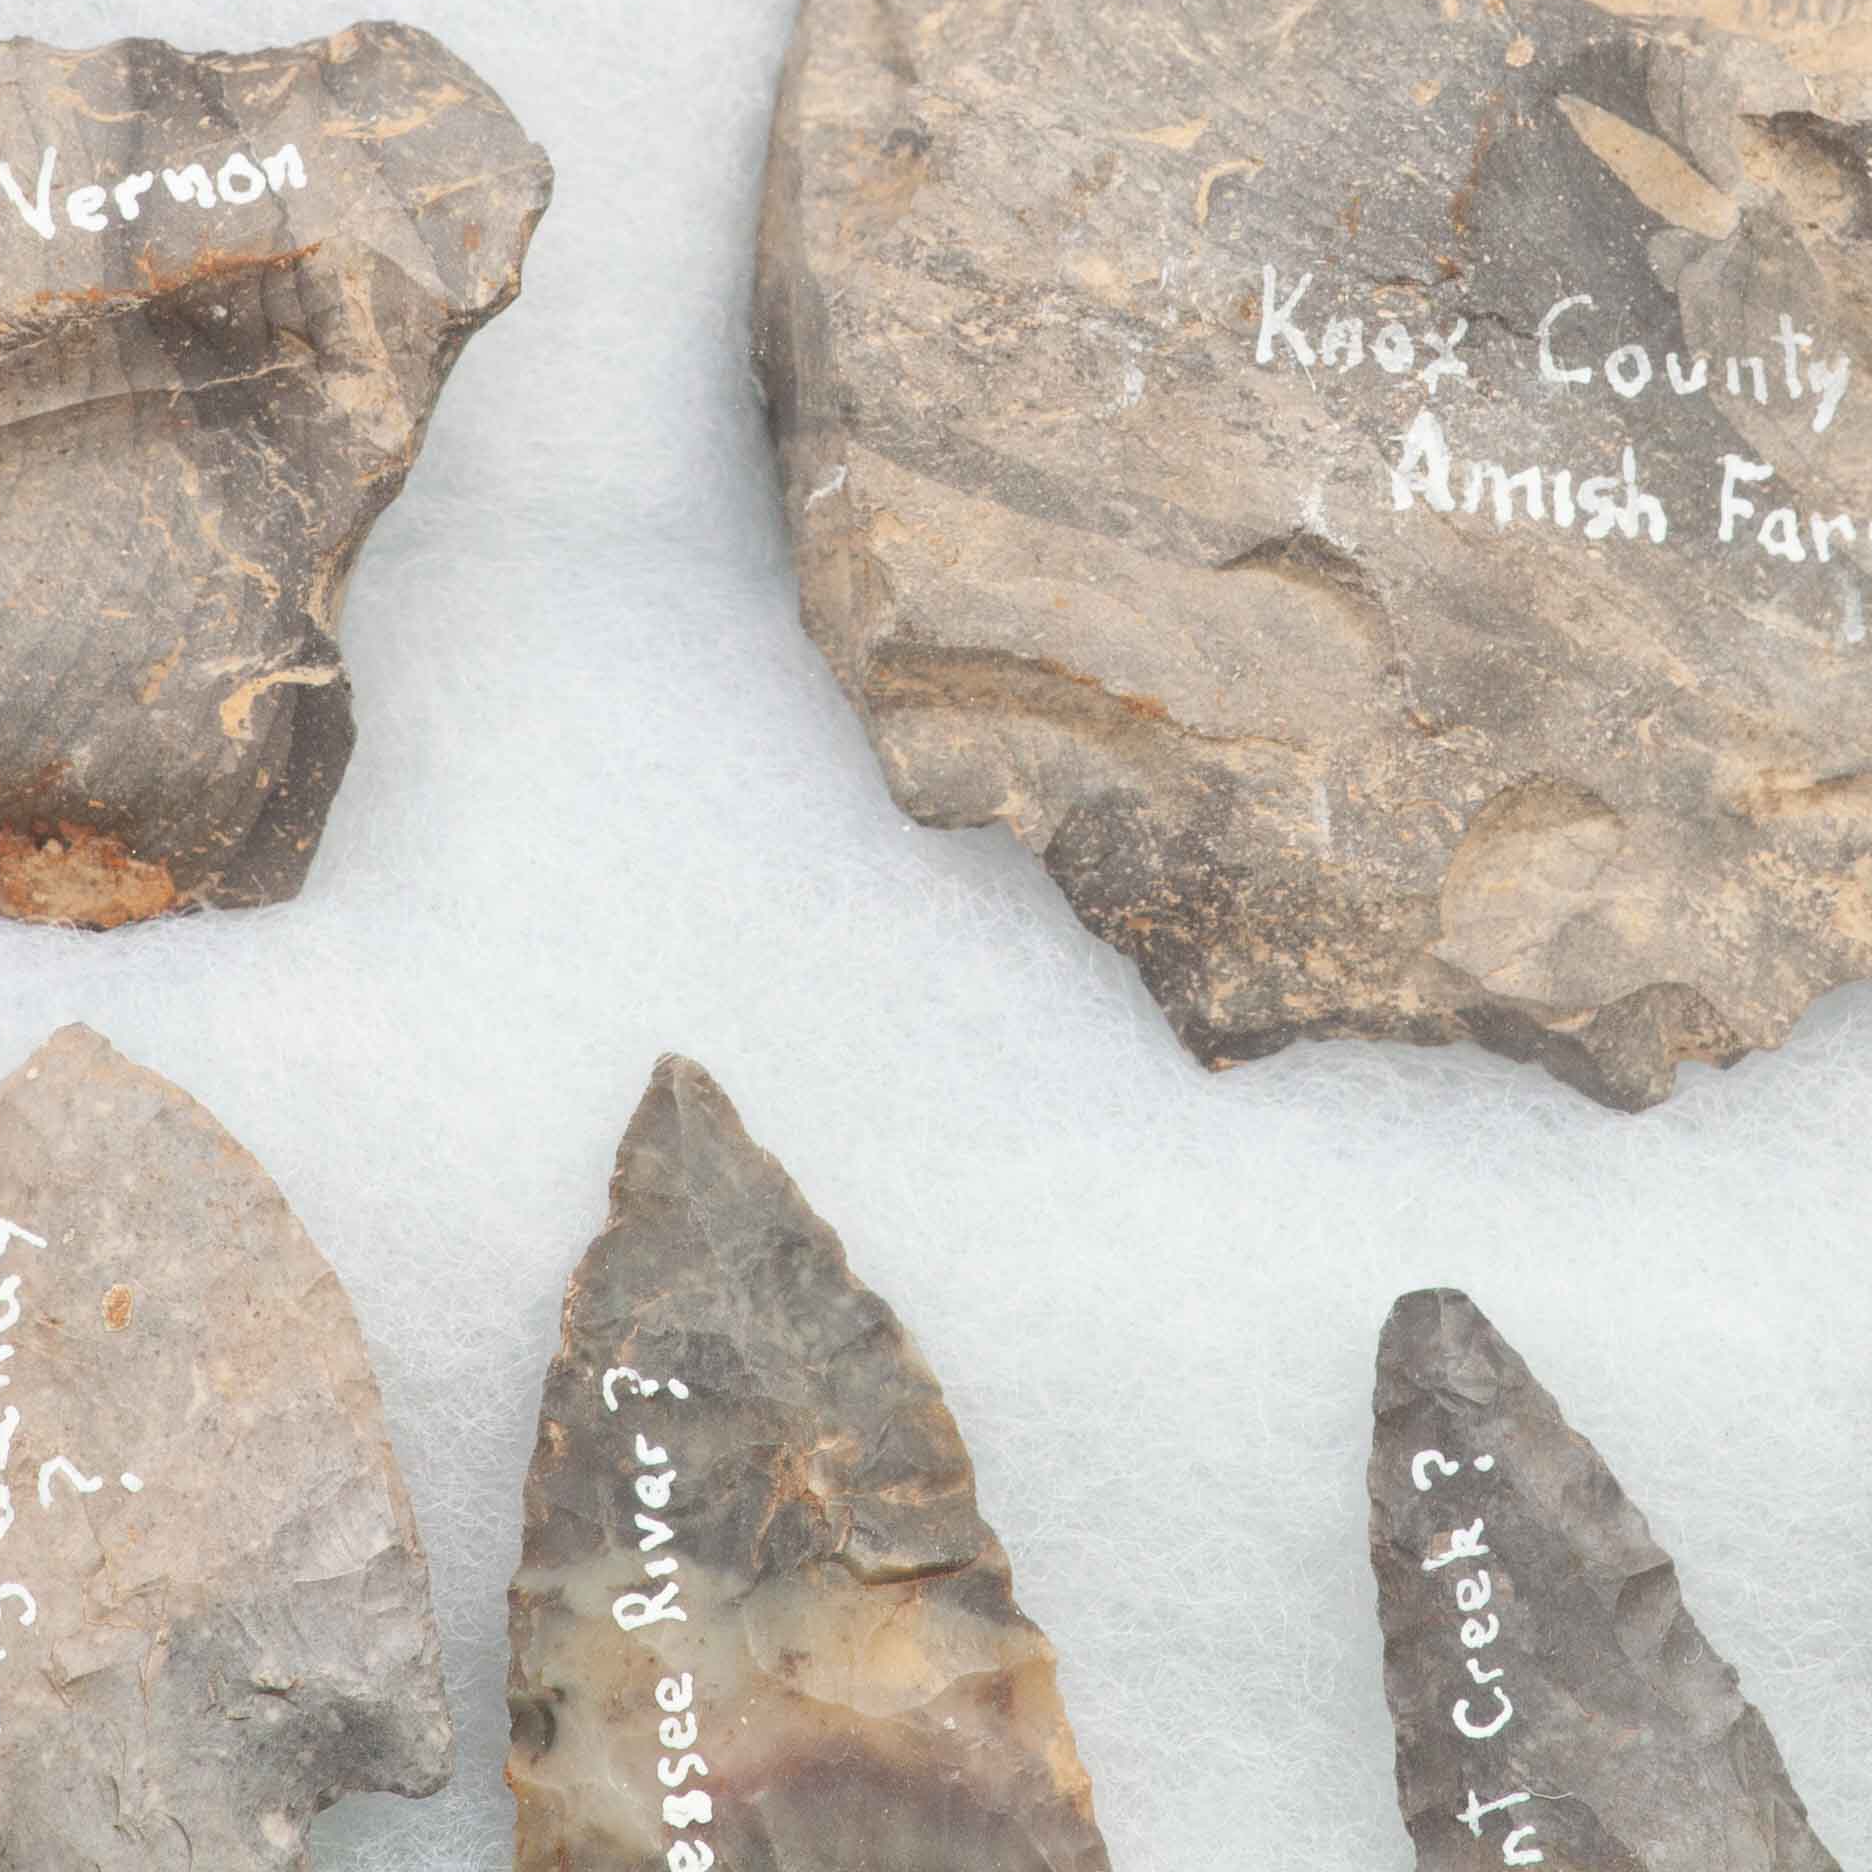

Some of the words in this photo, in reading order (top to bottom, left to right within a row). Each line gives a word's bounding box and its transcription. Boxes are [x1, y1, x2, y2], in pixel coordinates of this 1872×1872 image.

[1255, 264, 1467, 394] Knox
[1536, 294, 1851, 433] County
[1389, 412, 1669, 545] Amish
[38, 1455, 144, 1509] ?
